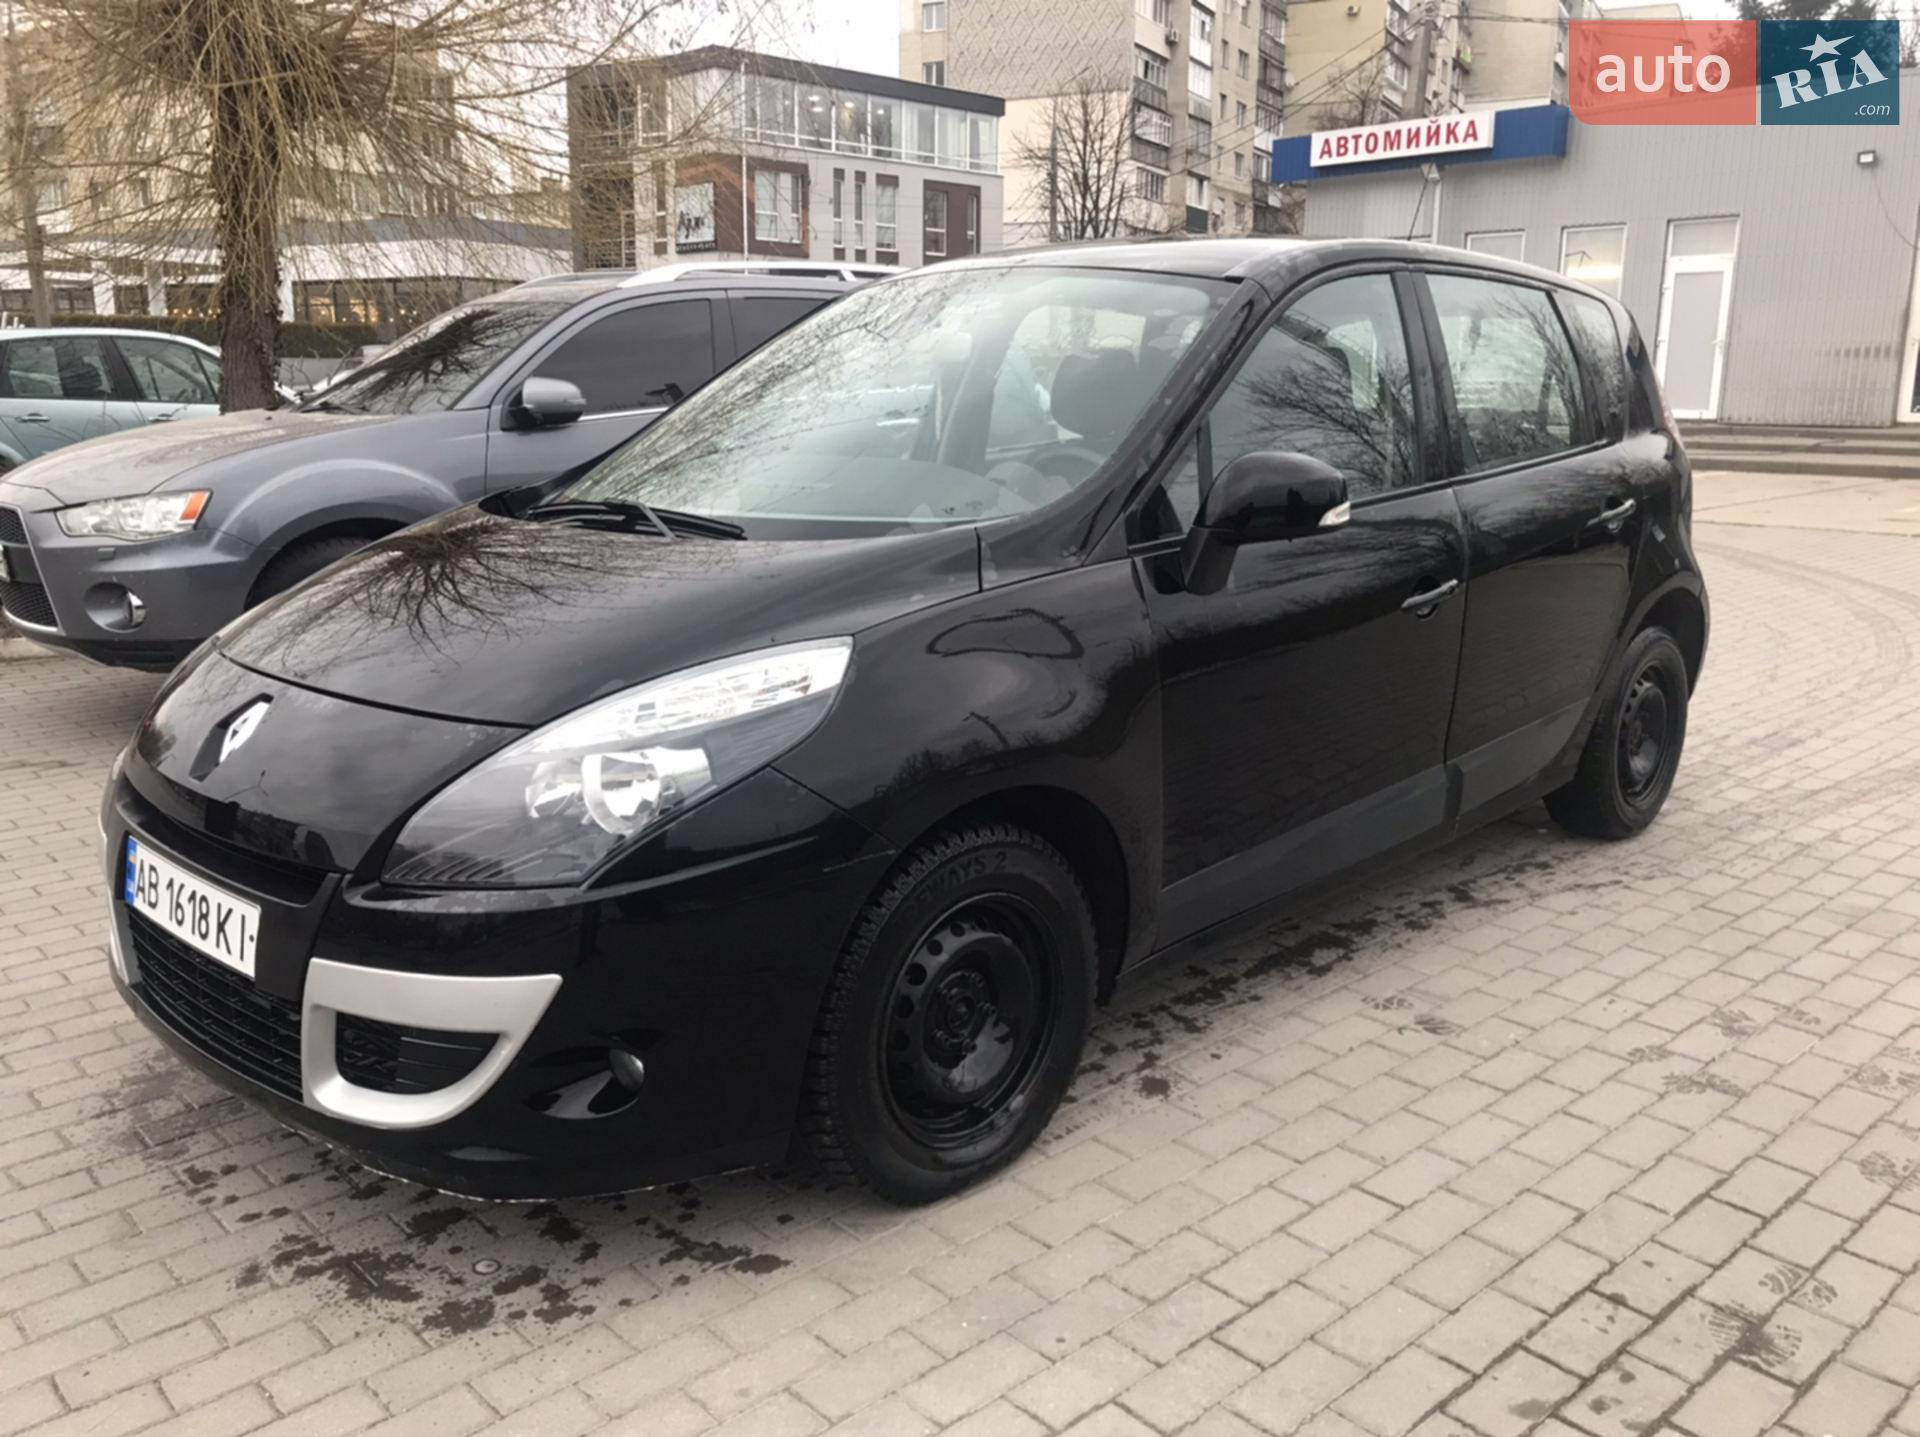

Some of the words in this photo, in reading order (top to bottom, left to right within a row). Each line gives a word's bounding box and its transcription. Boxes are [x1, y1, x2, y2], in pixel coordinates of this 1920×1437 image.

[1318, 118, 1479, 160] АВТОМИЙКА
[993, 850, 1008, 872] 2
[136, 858, 160, 910] AB
[166, 876, 210, 941] 1618
[216, 902, 246, 962] KI
